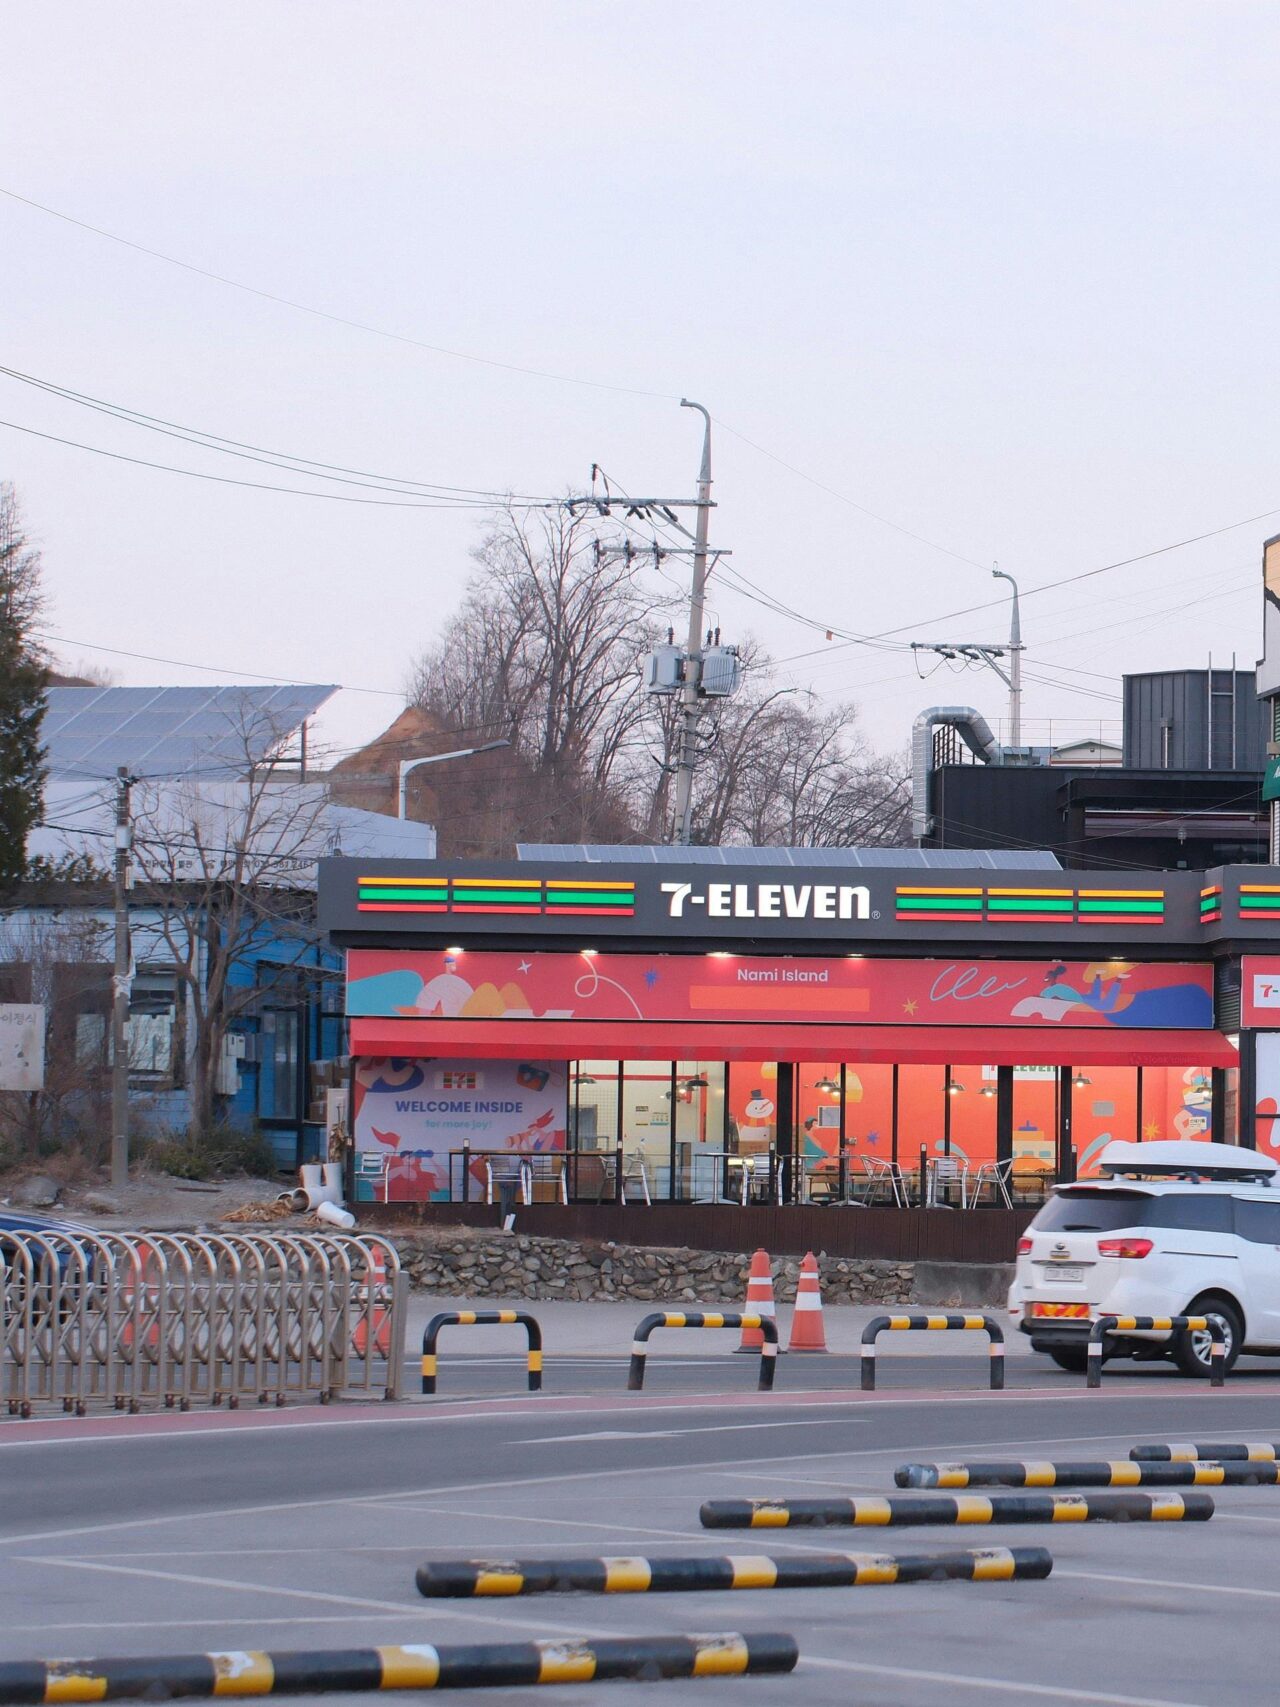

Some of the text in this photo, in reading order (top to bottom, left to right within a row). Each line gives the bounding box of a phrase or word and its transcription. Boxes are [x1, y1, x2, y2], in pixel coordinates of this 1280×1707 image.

[737, 968, 828, 983] Nami Island
[395, 1101, 523, 1114] WELCOME INSIDE
